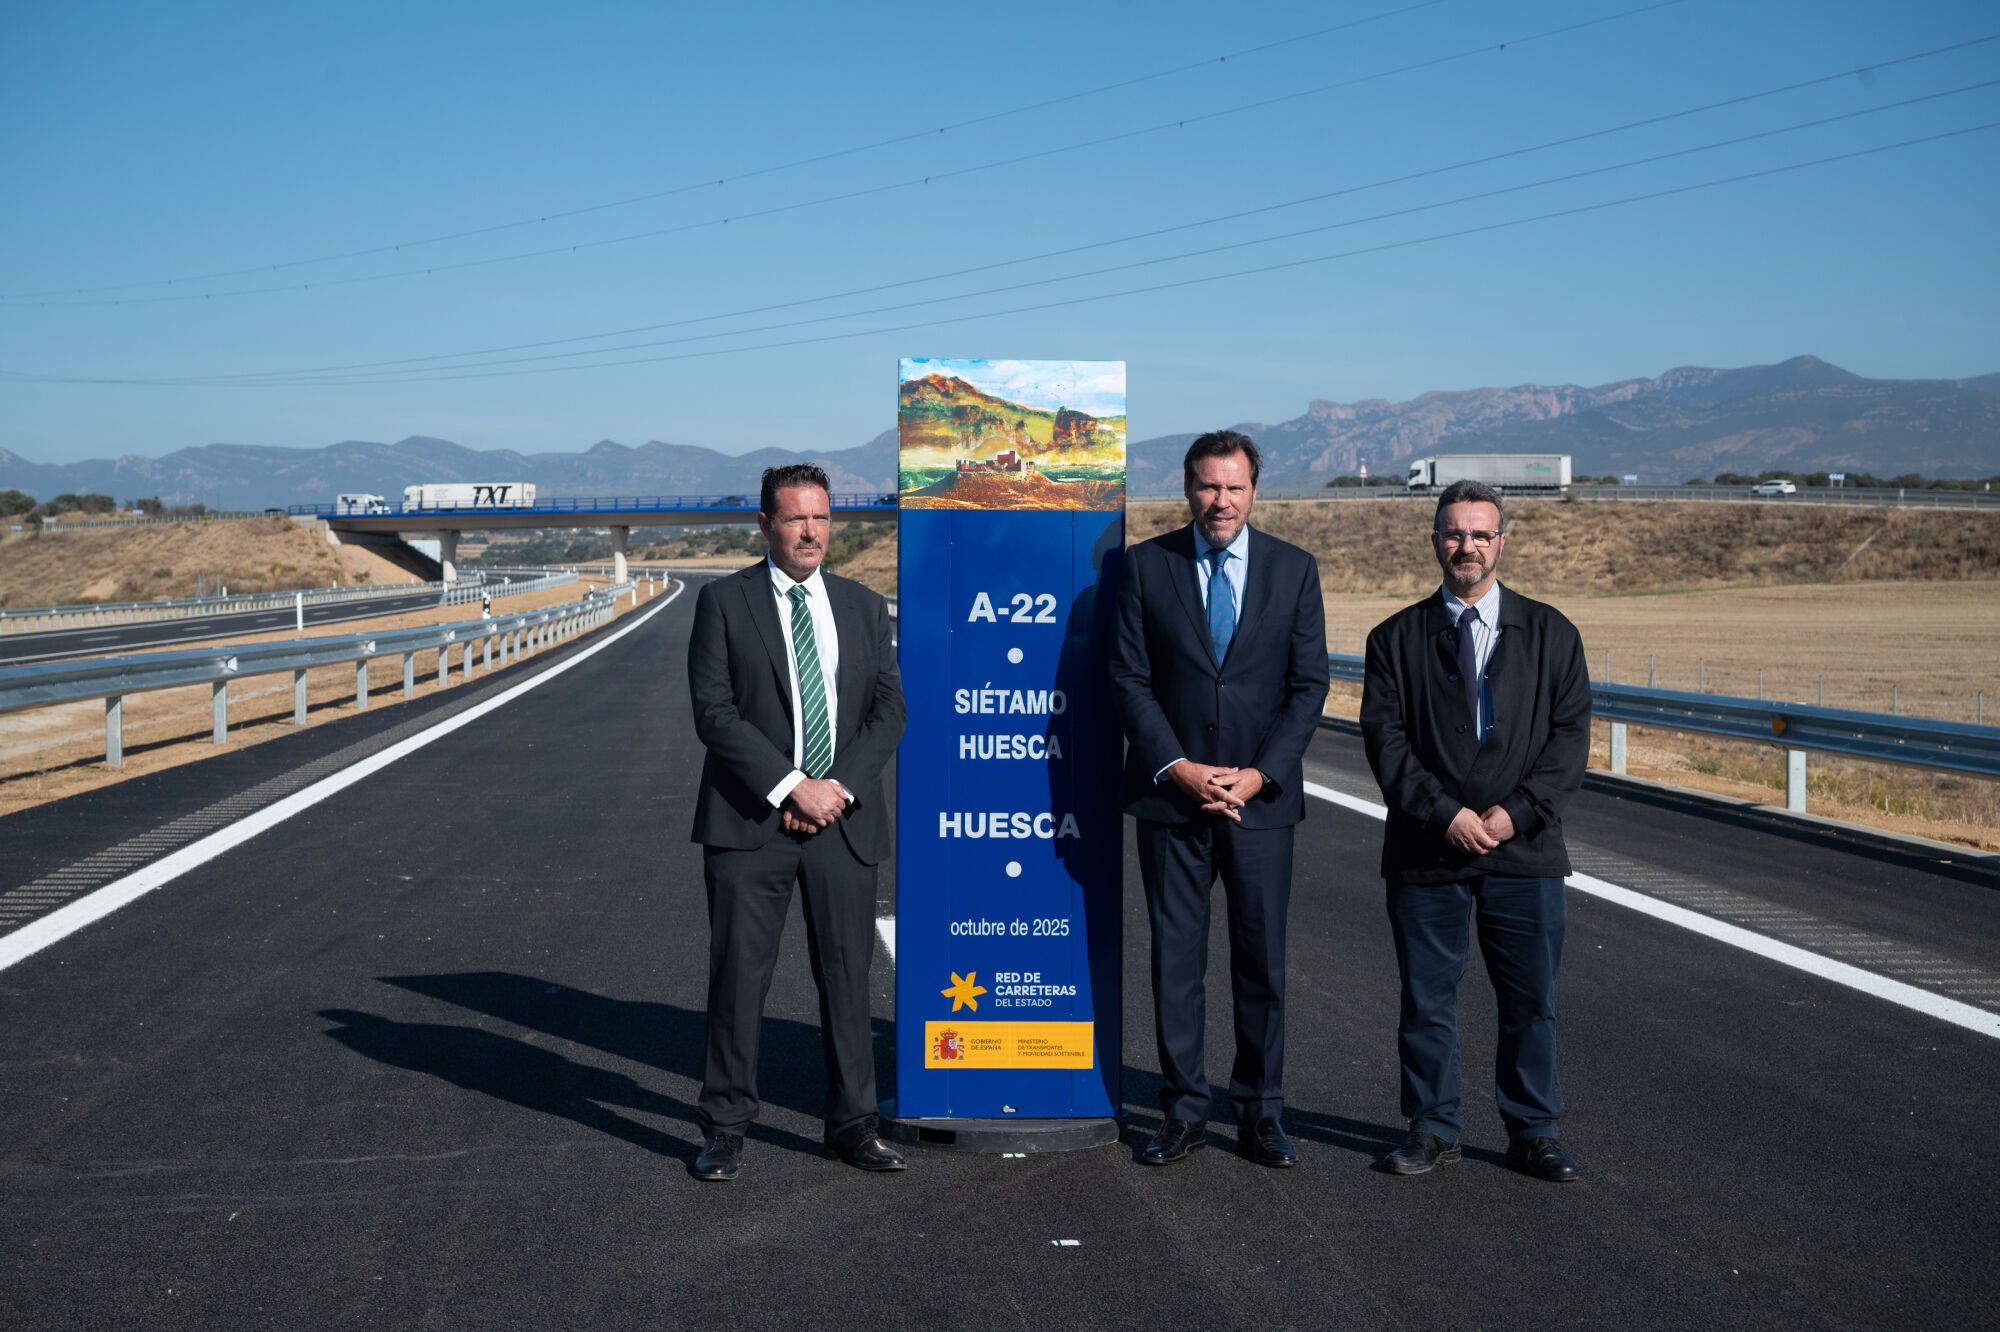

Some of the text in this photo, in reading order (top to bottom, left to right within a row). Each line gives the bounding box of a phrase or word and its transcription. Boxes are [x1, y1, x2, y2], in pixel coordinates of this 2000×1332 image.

[473, 486, 512, 504] TXT
[968, 592, 1057, 624] A-22
[954, 681, 1067, 715] SIÉTAMO
[959, 734, 1063, 760] HUESCA
[939, 812, 1081, 839] HUESCA
[950, 918, 1070, 937] octubre de 2025
[995, 972, 1041, 983] RED DE
[995, 985, 1077, 996] CARRETERAS
[995, 998, 1052, 1007] DEL ESTADO
